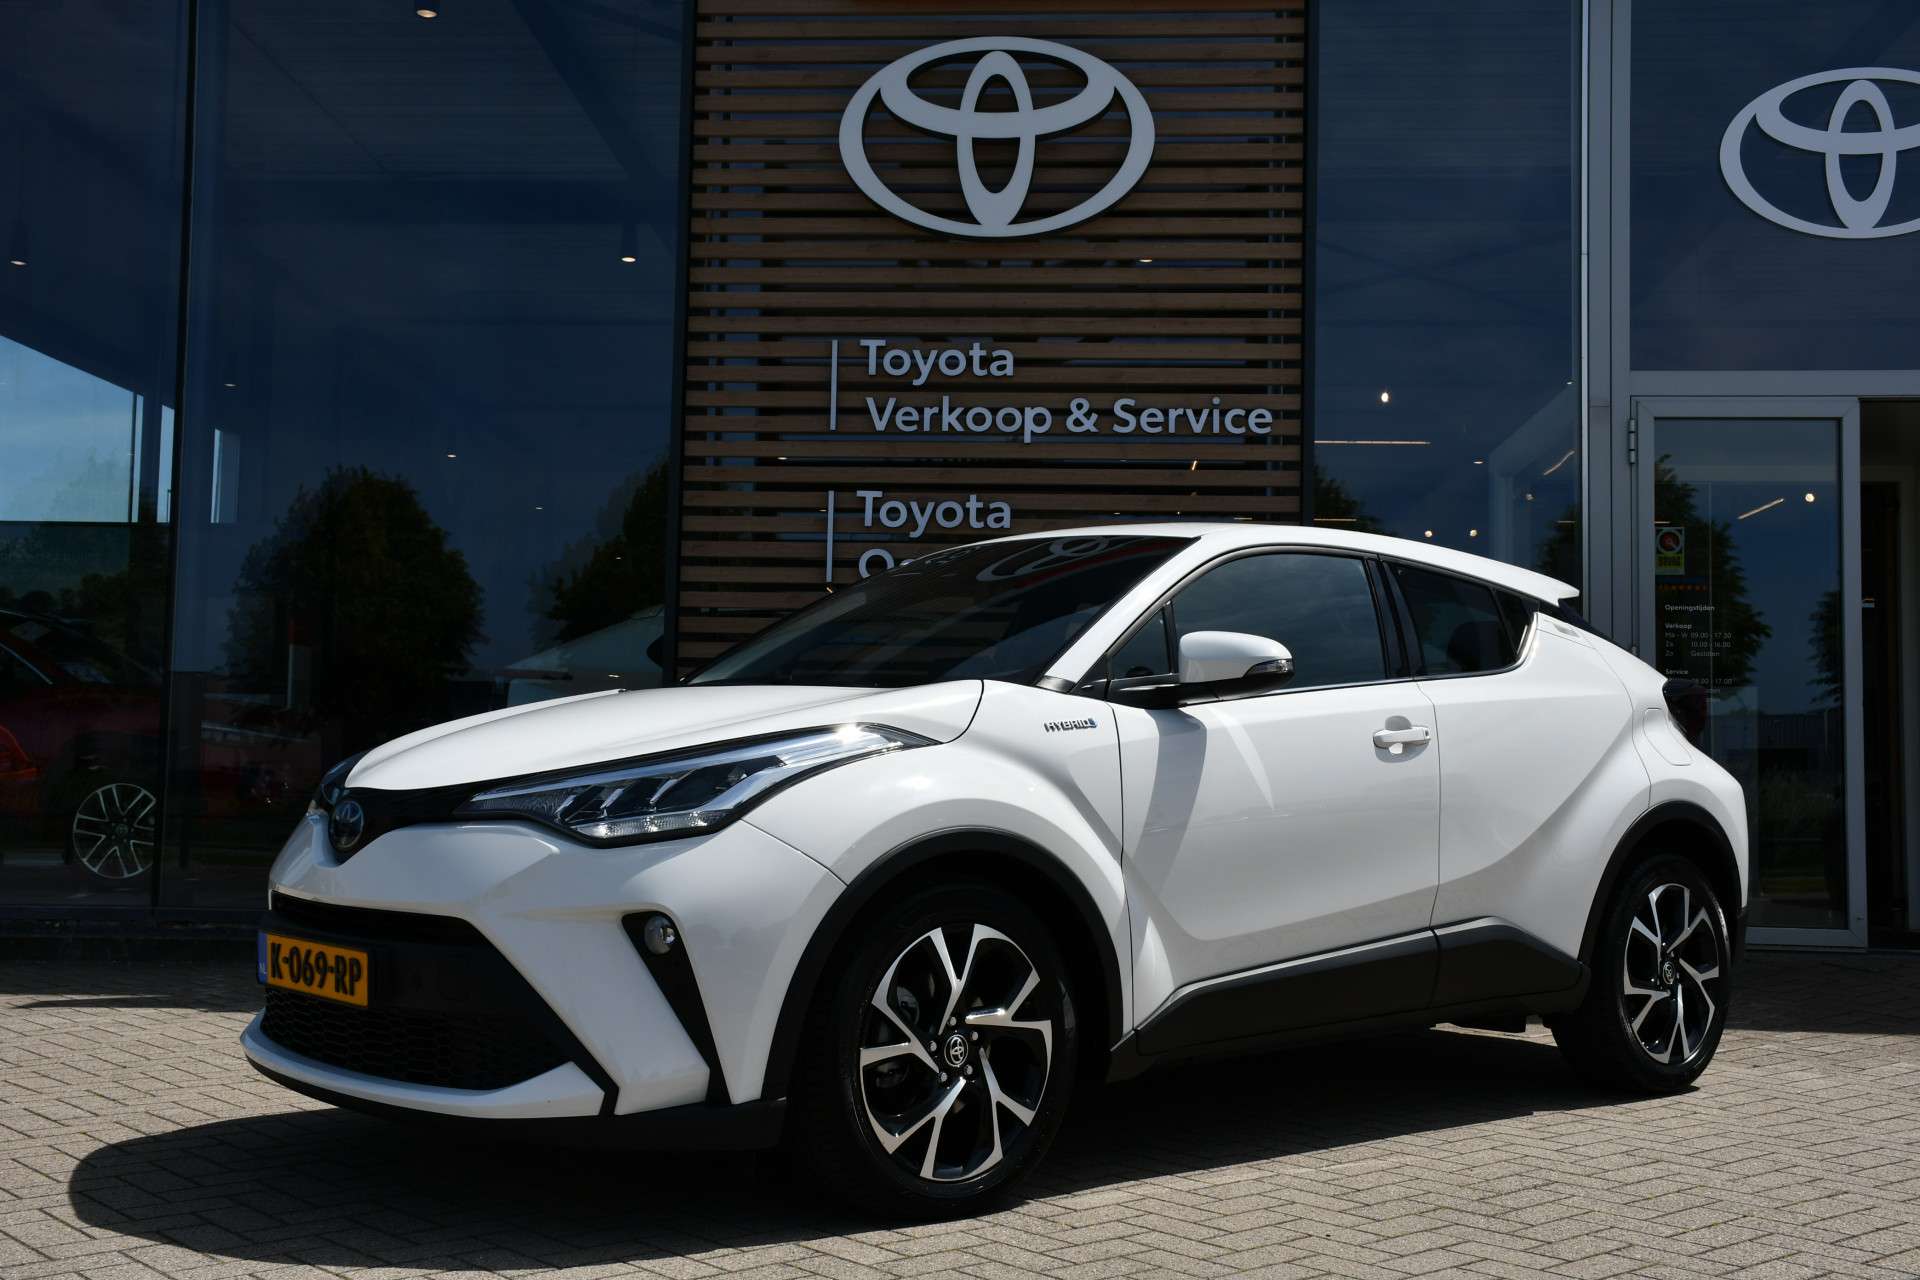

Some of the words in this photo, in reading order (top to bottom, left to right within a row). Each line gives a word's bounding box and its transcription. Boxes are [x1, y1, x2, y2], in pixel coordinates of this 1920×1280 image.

[860, 339, 1014, 385] Toyota
[866, 395, 1052, 443] Verkoop
[1067, 398, 1099, 433] &
[1112, 396, 1273, 434] Service
[856, 490, 1012, 537] Toyota
[1044, 719, 1091, 732] HYBRID
[270, 942, 362, 996] K-069-RP
